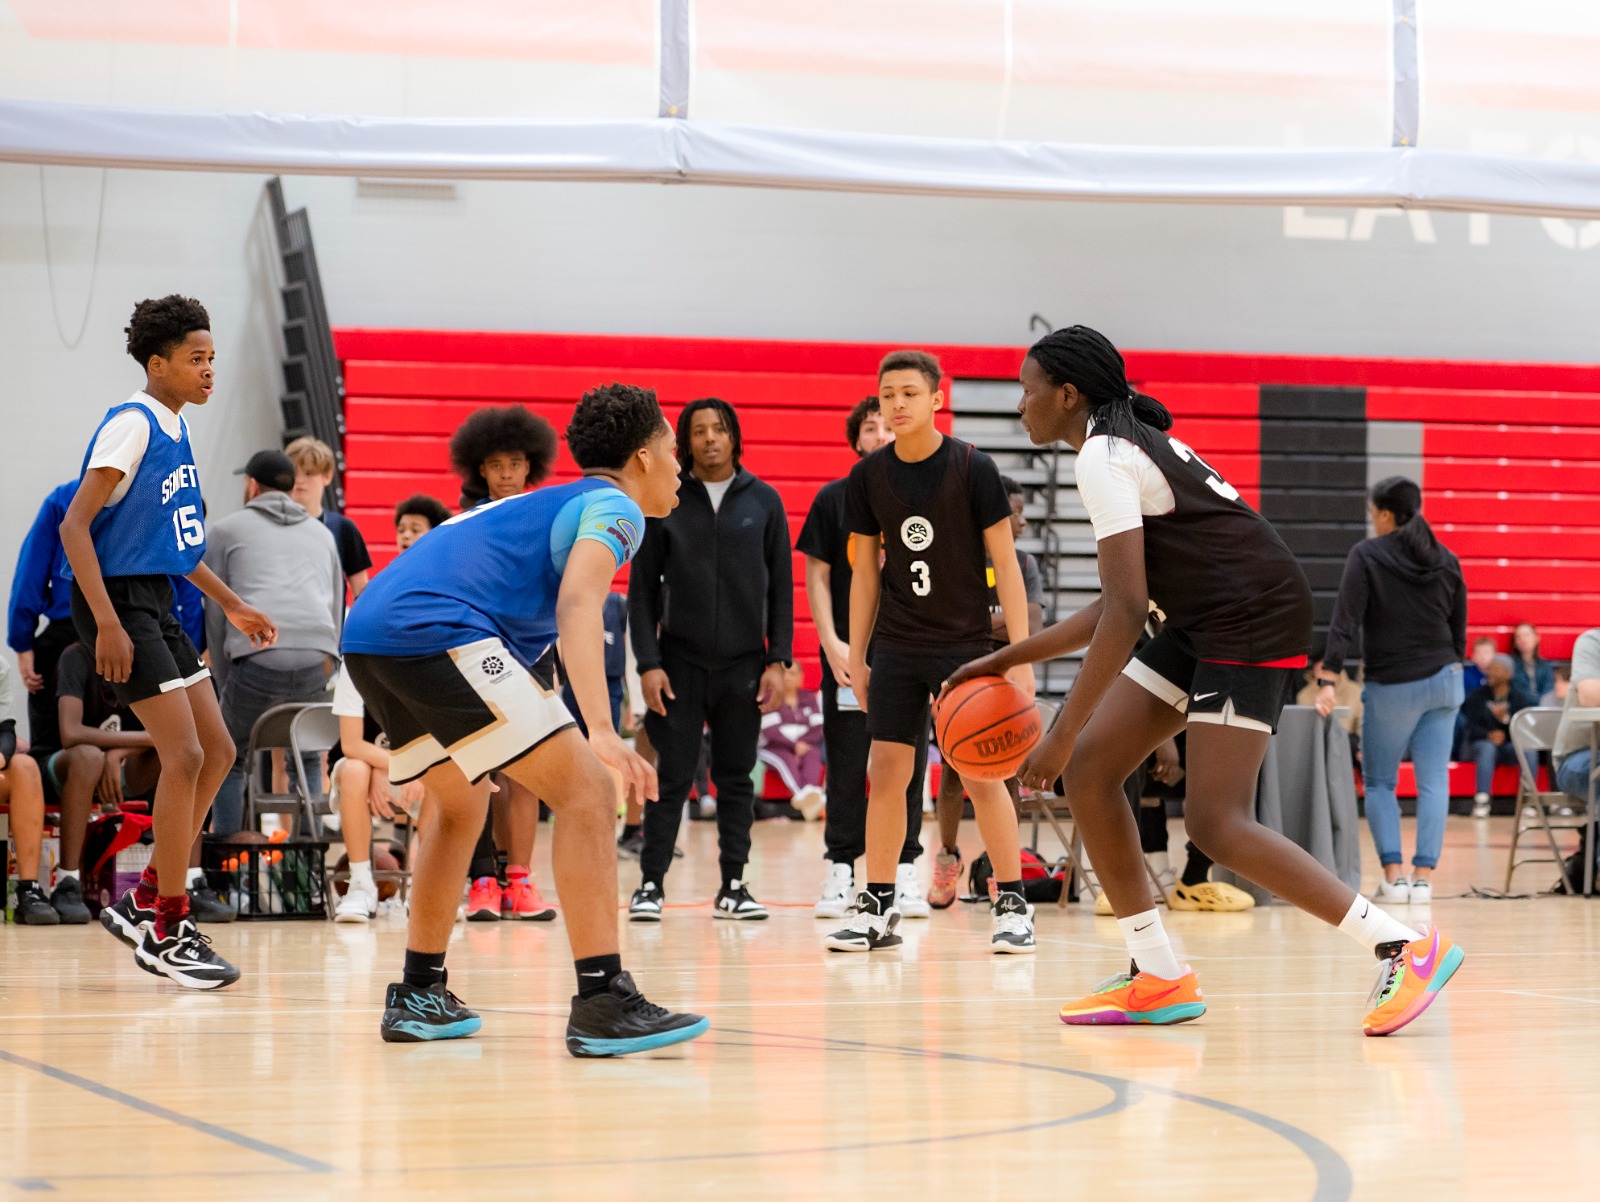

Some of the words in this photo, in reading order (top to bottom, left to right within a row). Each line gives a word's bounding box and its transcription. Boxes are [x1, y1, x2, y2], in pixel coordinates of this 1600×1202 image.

[172, 504, 205, 552] 15
[909, 560, 932, 597] 3
[973, 721, 1039, 758] Wilson
